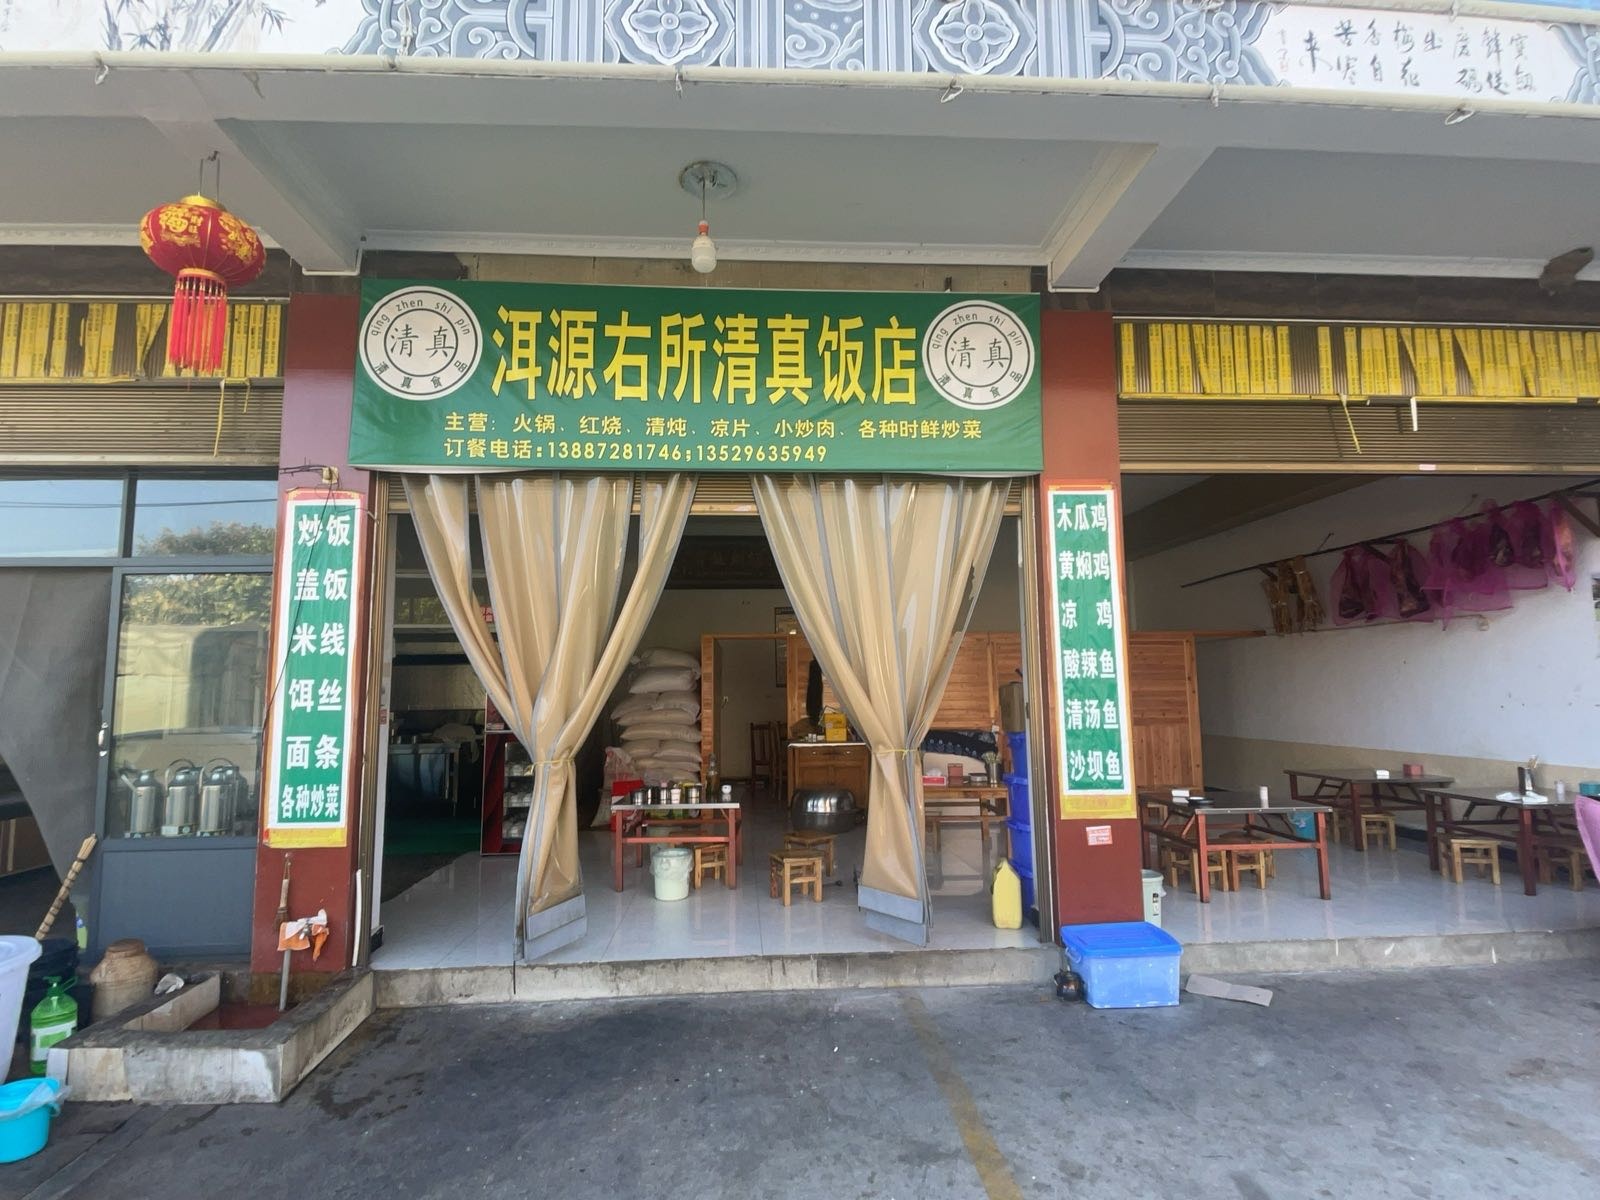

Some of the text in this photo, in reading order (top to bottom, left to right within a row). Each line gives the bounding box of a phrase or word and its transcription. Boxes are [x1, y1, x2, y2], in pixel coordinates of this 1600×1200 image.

[371, 299, 471, 336] qing zhen shi pin
[932, 313, 1023, 349] qing zhen shi pin
[390, 323, 455, 358] 清真
[491, 305, 917, 405] 洱源右所清真饭店
[950, 336, 1009, 369] 清真
[297, 513, 351, 547] 炒饭
[1056, 502, 1108, 532] 木瓜鸡
[1058, 550, 1111, 581] 黄焖鸡
[293, 567, 349, 601] 盖饭
[290, 622, 346, 657] 米线
[1062, 648, 1116, 679] 酸辣鱼
[288, 678, 343, 713] 饵丝
[1066, 698, 1119, 730] 清汤鱼
[285, 734, 341, 770] 面条
[1069, 749, 1123, 781] 沙坝鱼
[281, 783, 340, 819] 各种炒菜
